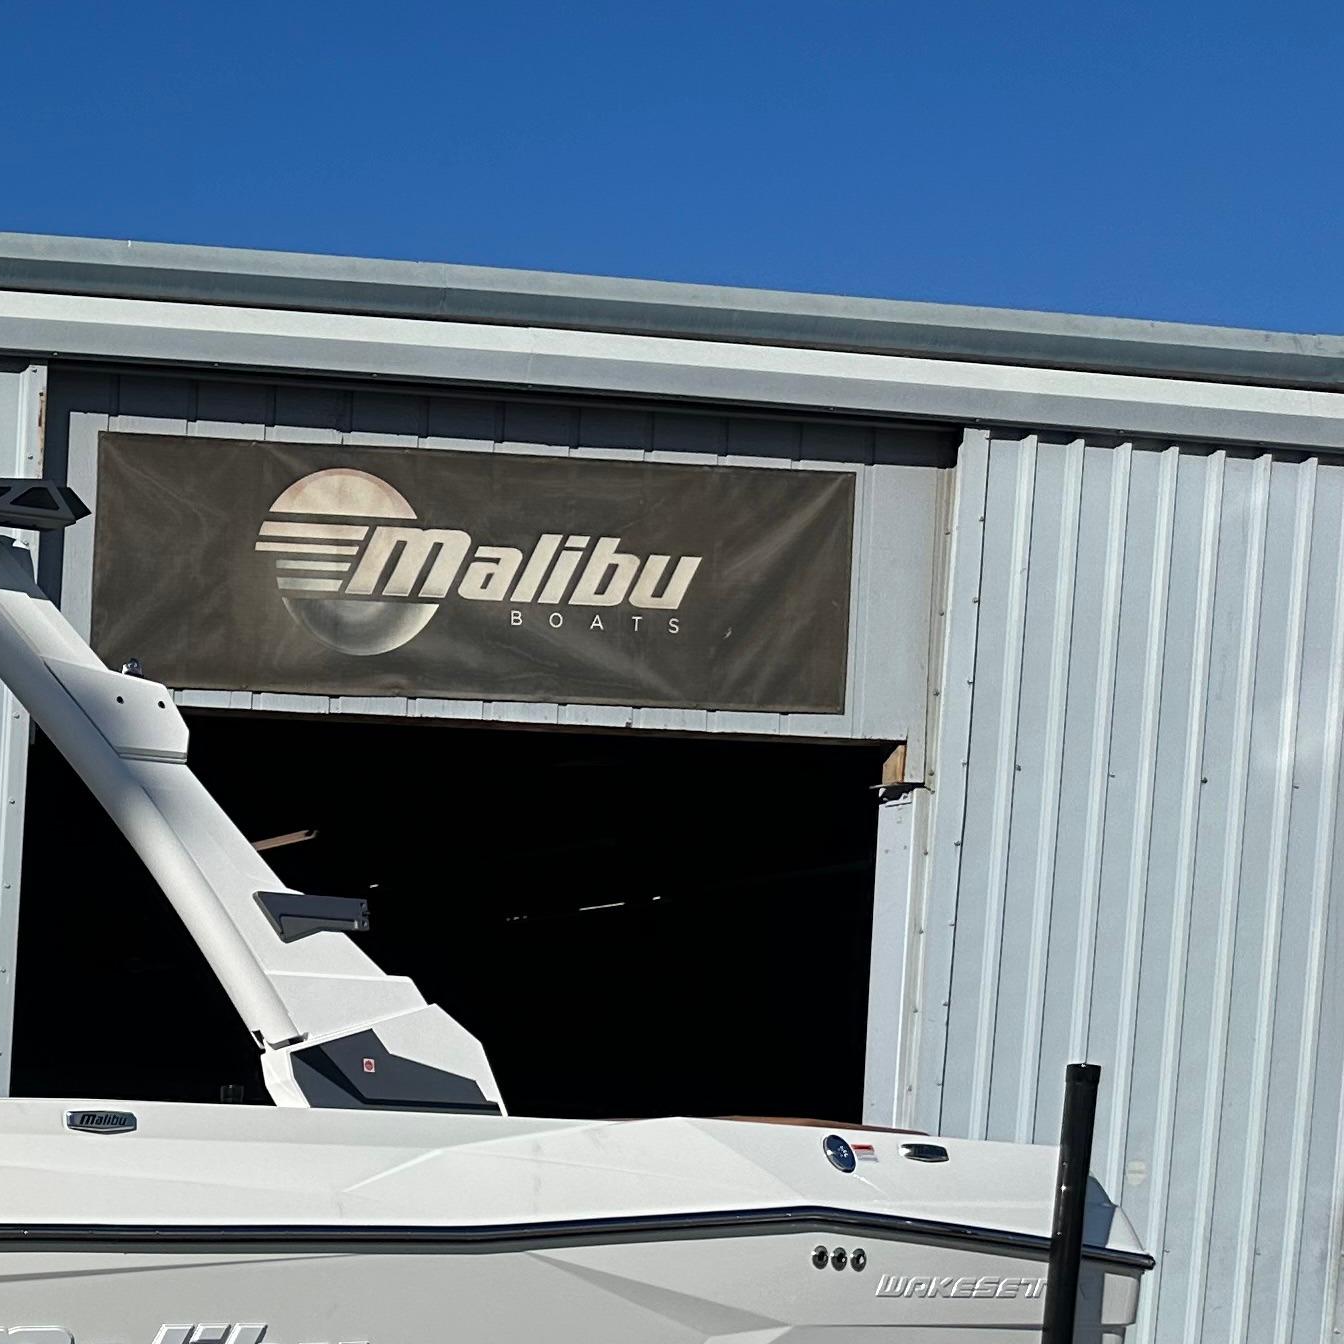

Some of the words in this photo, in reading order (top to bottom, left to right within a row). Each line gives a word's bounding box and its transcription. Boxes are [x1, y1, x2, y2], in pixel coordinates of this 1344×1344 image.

[345, 526, 702, 610] Malibu
[510, 610, 680, 634] BOATS
[80, 1113, 127, 1126] Malibu
